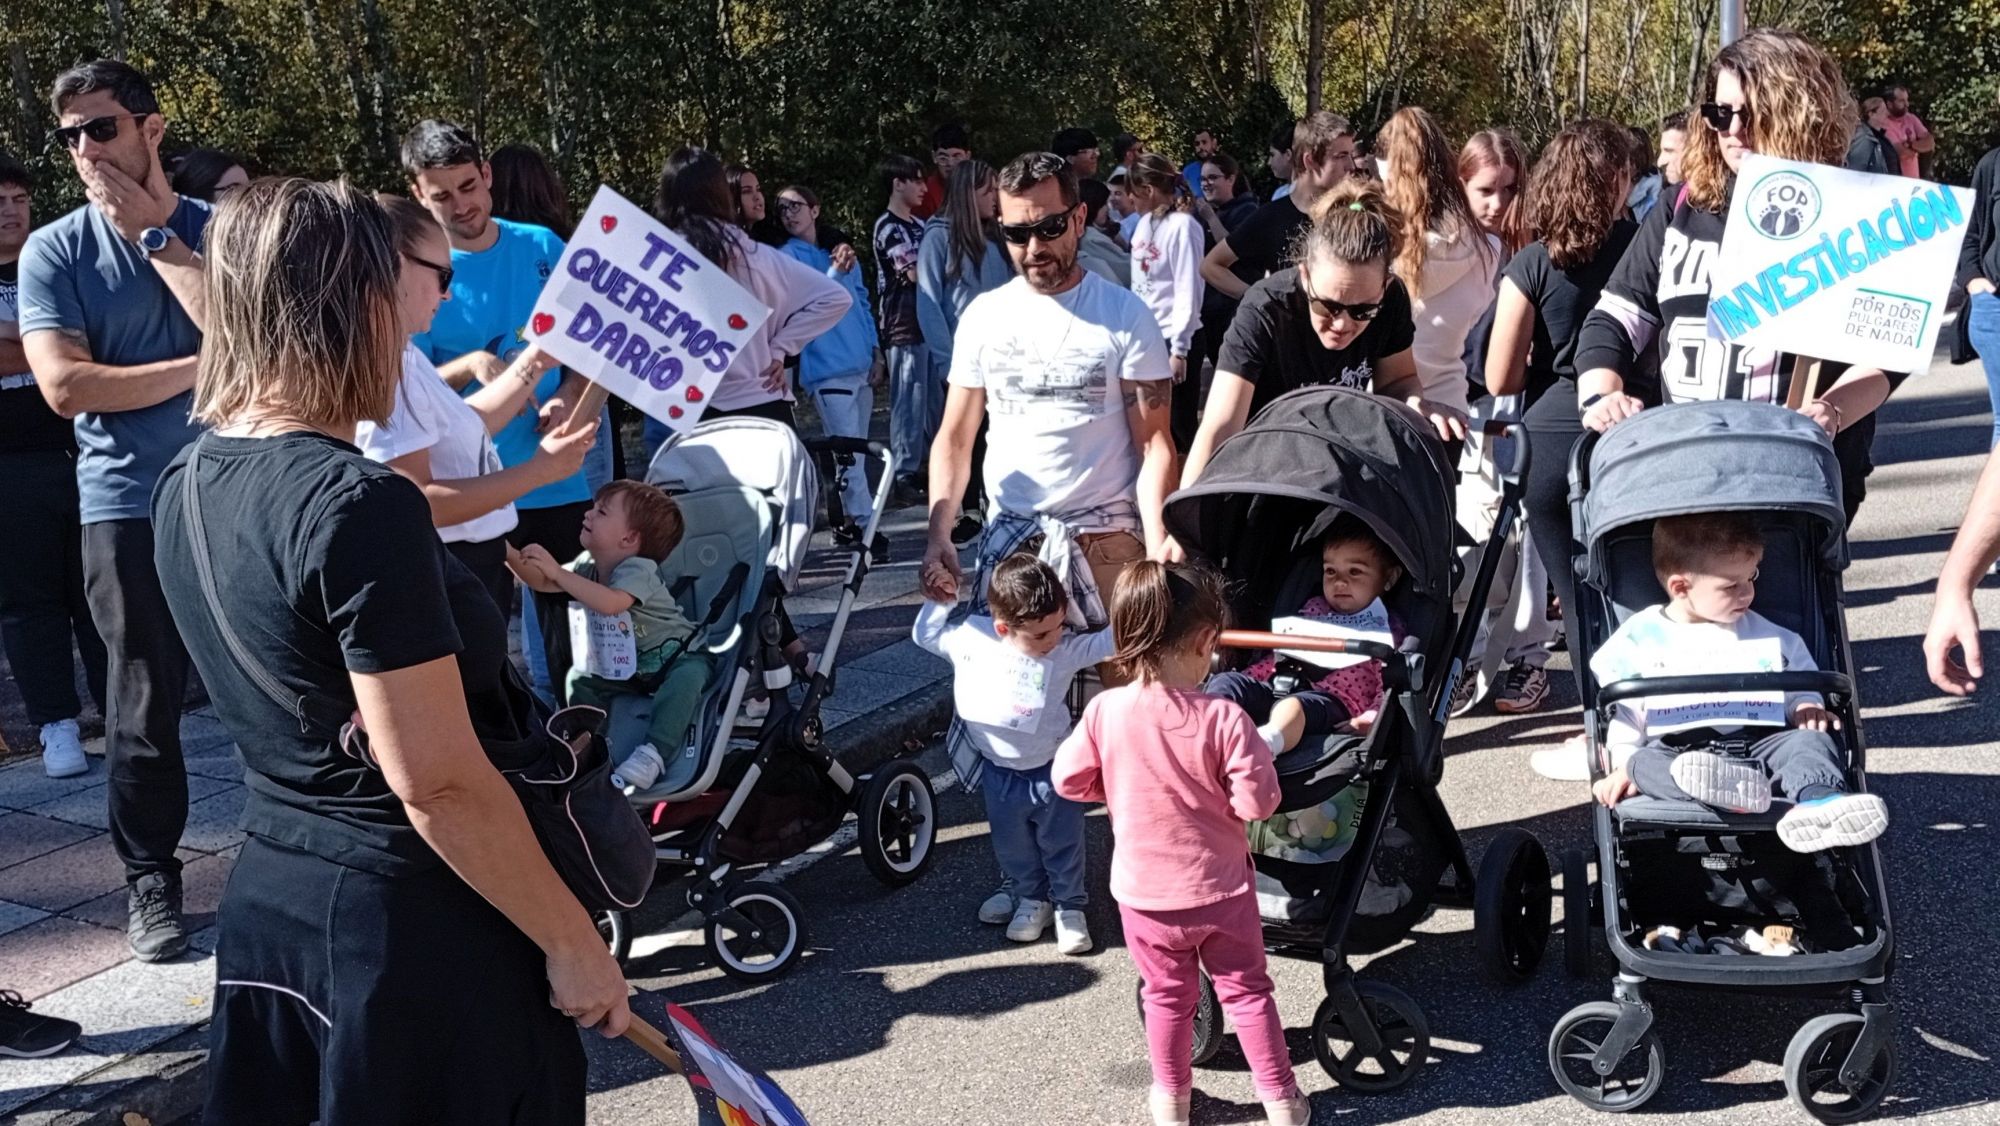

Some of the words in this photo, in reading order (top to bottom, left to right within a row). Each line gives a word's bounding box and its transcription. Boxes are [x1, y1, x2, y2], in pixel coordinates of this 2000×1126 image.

[1766, 184, 1808, 206] FOP
[638, 231, 700, 293] TE
[566, 247, 737, 374] QUEREMOS
[1848, 311, 1919, 333] PULGARES
[565, 301, 684, 392] DARÍO
[1845, 322, 1867, 337] DE
[1869, 327, 1913, 347] NADA
[612, 655, 630, 665] 1002
